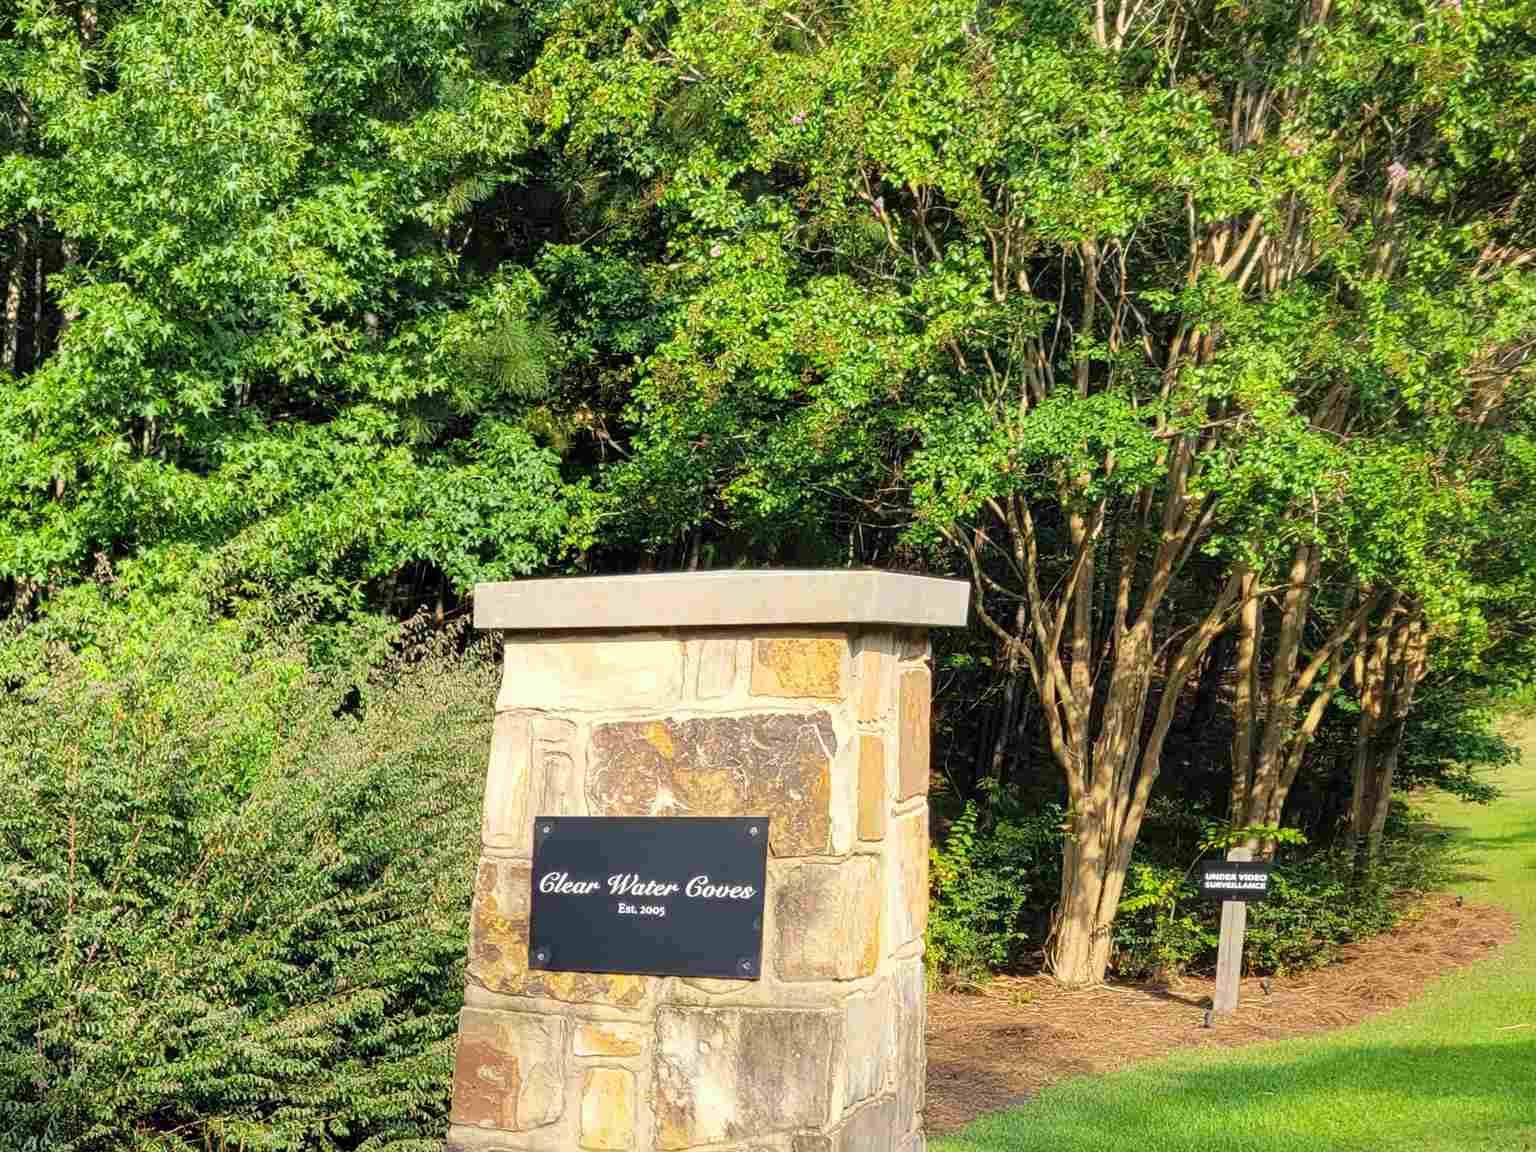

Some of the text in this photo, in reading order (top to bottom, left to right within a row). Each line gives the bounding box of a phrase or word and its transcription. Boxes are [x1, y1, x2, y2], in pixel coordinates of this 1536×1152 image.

[1238, 873, 1267, 882] VIDEO
[539, 872, 757, 899] Clear Water Coves
[1205, 881, 1266, 889] SURVEILLANCE
[618, 903, 665, 917] Est. 2005
